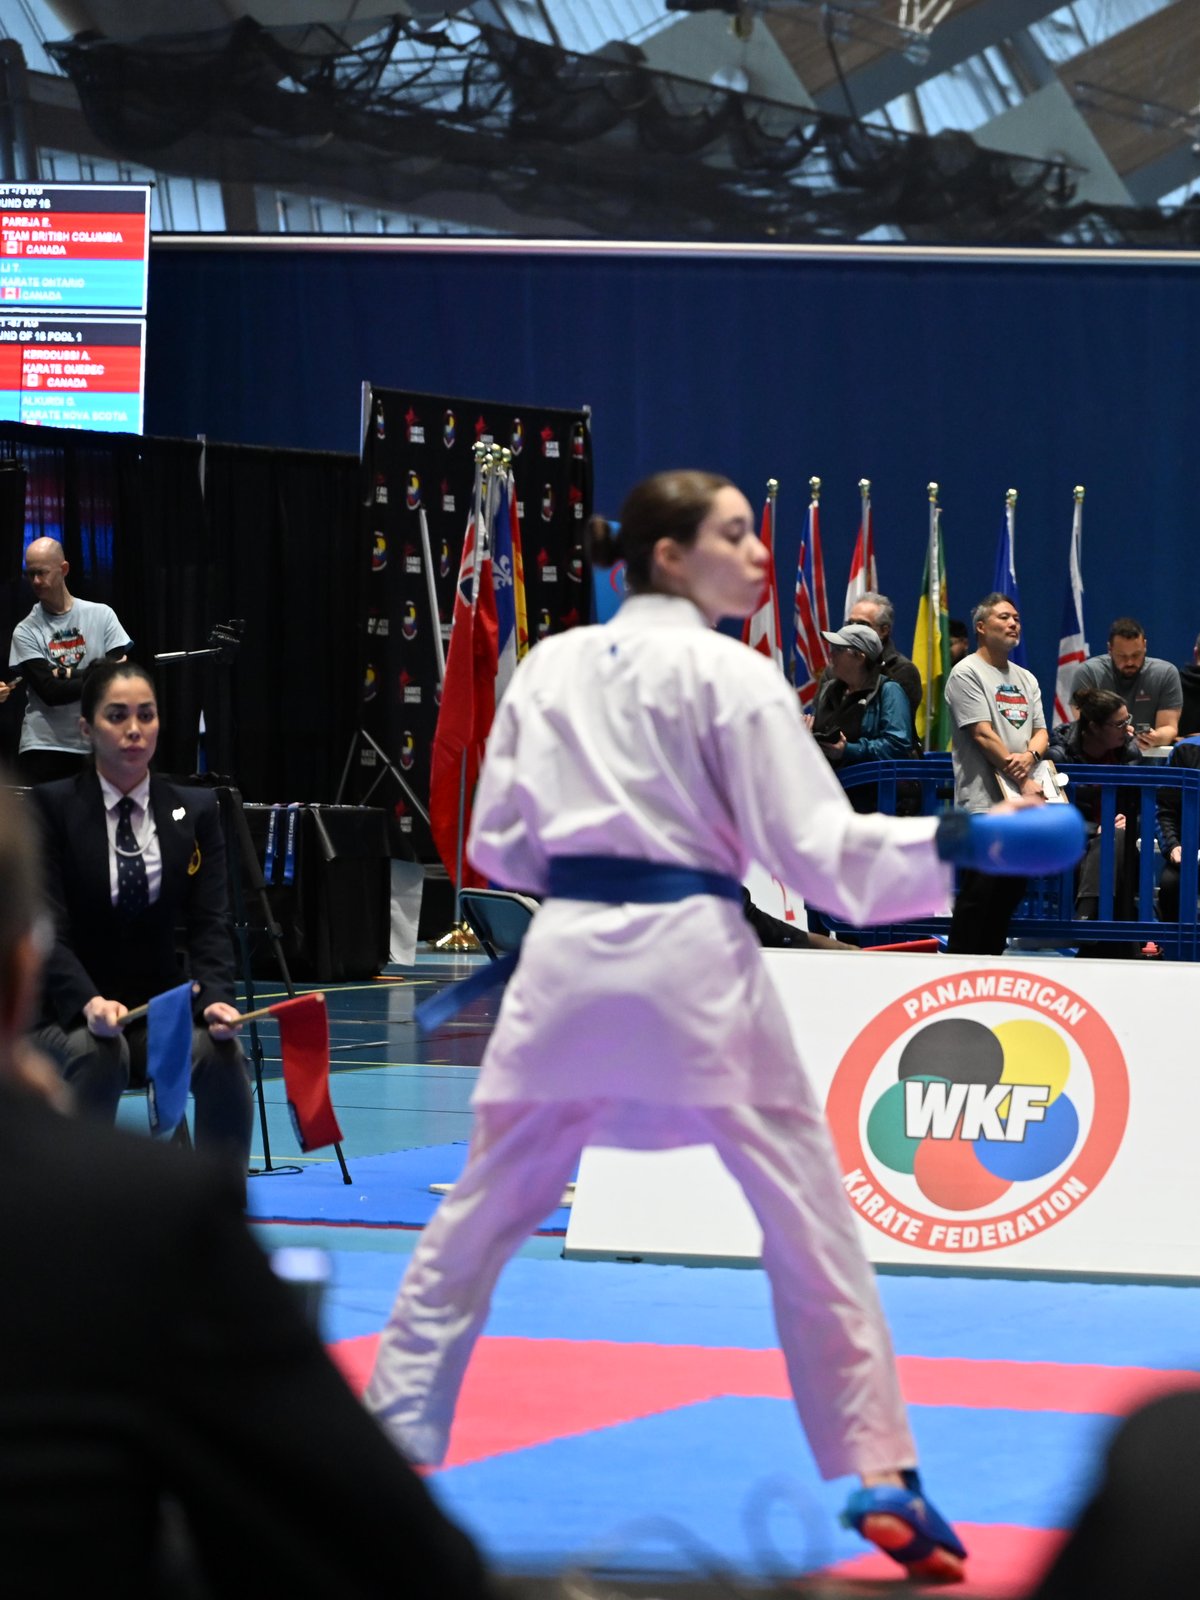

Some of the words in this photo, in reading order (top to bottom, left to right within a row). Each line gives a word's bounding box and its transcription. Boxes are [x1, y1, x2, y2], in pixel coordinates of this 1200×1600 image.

[0, 198, 21, 208] UND
[23, 198, 37, 208] OF
[39, 198, 51, 209] 16
[2, 230, 30, 241] TEAM
[31, 231, 70, 242] BRITISH
[71, 232, 123, 243] COLUMBIA
[26, 245, 66, 255] CANADA
[0, 277, 39, 287] KARATE
[42, 278, 85, 288] ONTARIO
[19, 331, 33, 341] OF
[34, 331, 46, 341] 16
[47, 331, 75, 342] POOL
[76, 332, 82, 342] 1
[23, 363, 62, 374] KARATE
[64, 364, 104, 375] QUEBEC
[47, 377, 88, 388] CANADA
[902, 975, 1086, 1026] PANAMERICAN
[904, 1080, 1051, 1142] WKF
[841, 1168, 924, 1241] KARATE
[928, 1176, 1088, 1248] FEDERATION
